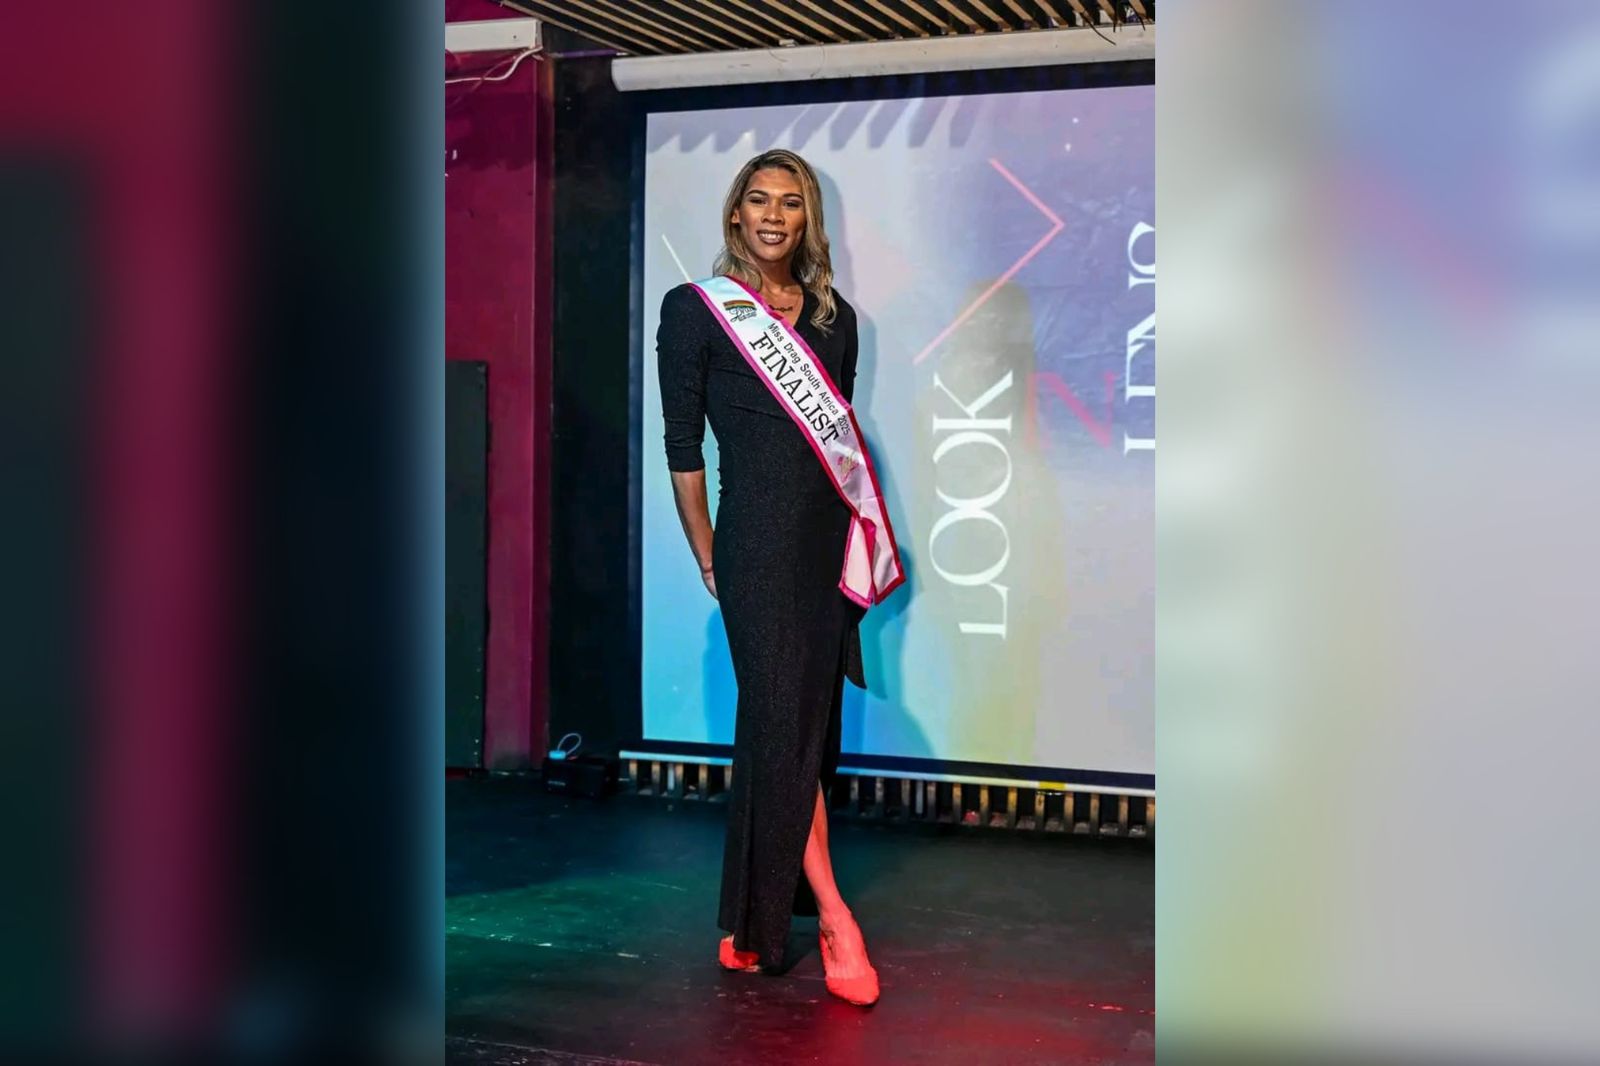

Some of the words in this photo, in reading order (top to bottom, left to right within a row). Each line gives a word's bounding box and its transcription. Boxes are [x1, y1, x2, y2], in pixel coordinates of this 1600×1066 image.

[749, 332, 839, 445] FINALIST
[768, 323, 784, 342] Miss
[784, 342, 800, 364] Drag
[800, 363, 821, 390] South
[819, 391, 838, 416] Africa
[837, 415, 850, 435] 2025
[929, 370, 1013, 639] LOOK
